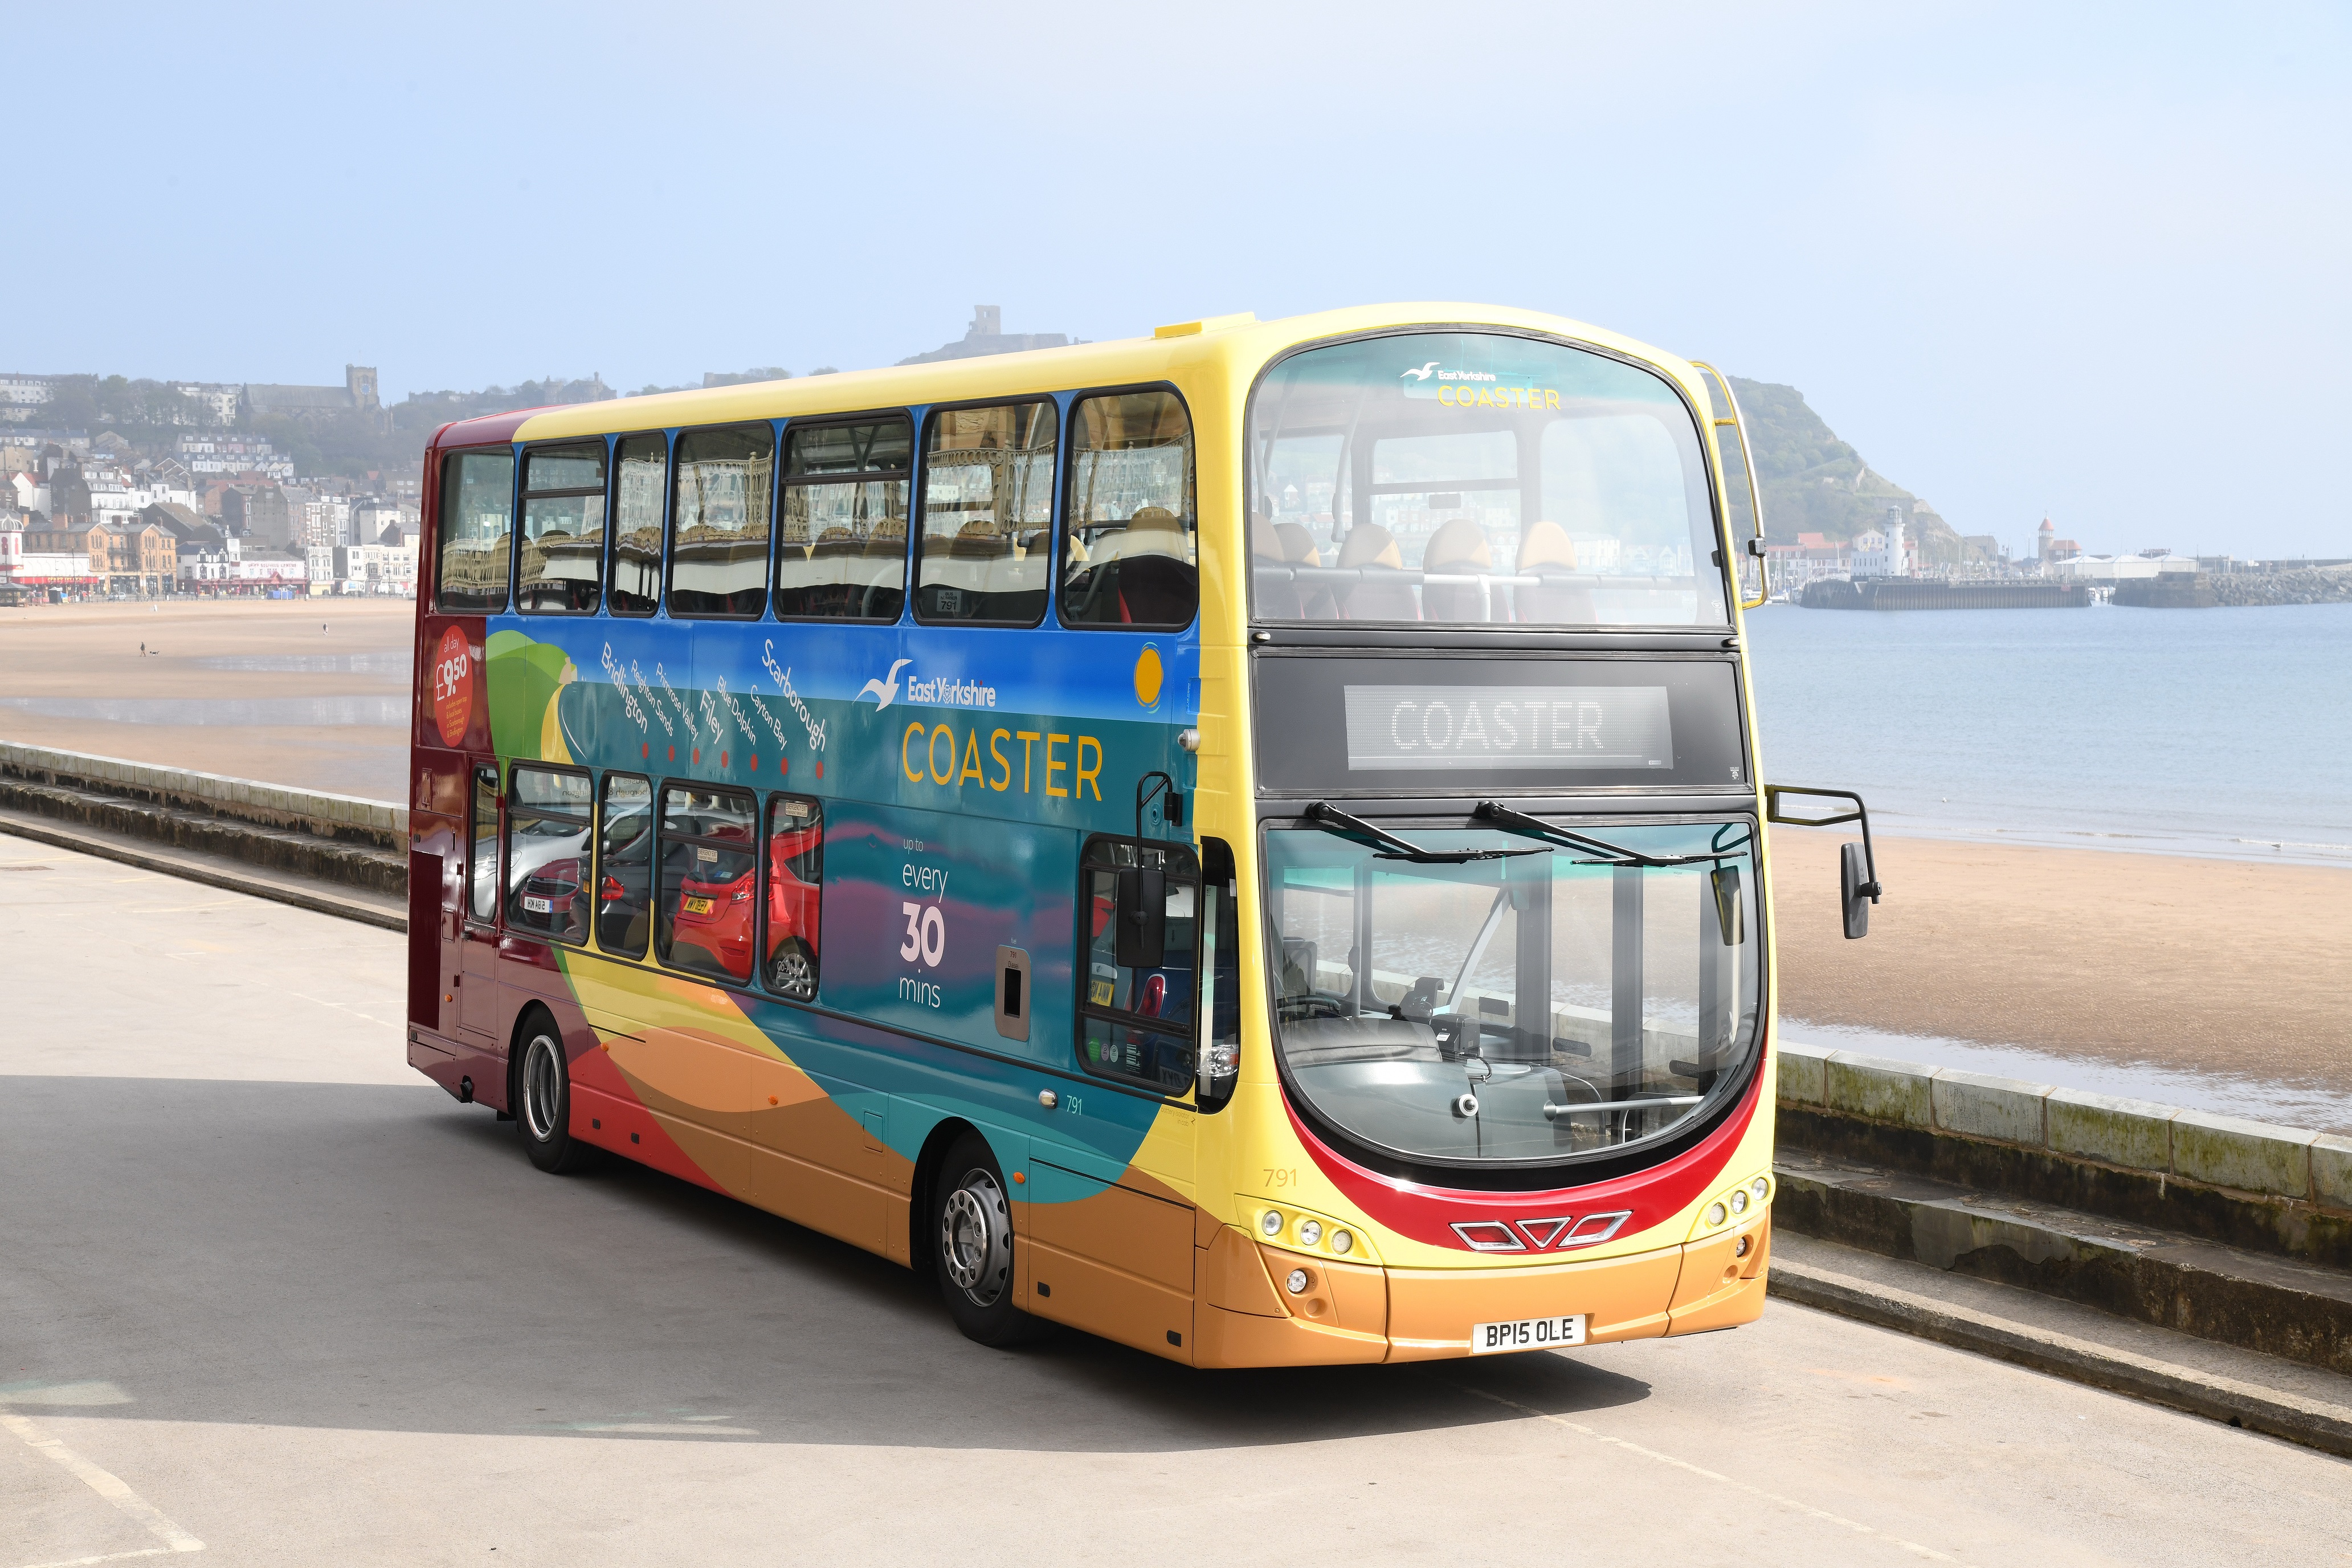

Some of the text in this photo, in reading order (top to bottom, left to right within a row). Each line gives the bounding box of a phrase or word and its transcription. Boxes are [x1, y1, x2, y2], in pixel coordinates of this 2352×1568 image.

[1438, 370, 1496, 382] East Yorkshire
[1438, 385, 1561, 410] COASTER
[941, 601, 957, 610] 791
[450, 634, 459, 651] day
[601, 641, 648, 734] Bridlington
[631, 659, 673, 737] Reighton Sands
[656, 662, 699, 741] Primrose Valley
[762, 639, 826, 752] Scarborough
[908, 676, 996, 707] East Yorkshire
[699, 688, 724, 745] Filey
[717, 675, 756, 745] Blue Dolphin
[750, 684, 787, 751] Cayton Bay
[1391, 701, 1604, 749] COASTER
[903, 721, 1102, 802] COASTER
[903, 838, 924, 855] up to
[903, 863, 948, 903] every
[900, 901, 945, 967] 30
[900, 969, 940, 1008] mins
[1067, 1095, 1082, 1116] 791
[1161, 1107, 1175, 1117] battery
[1263, 1169, 1296, 1187] 791
[1486, 1318, 1574, 1346] BP15 OLE
